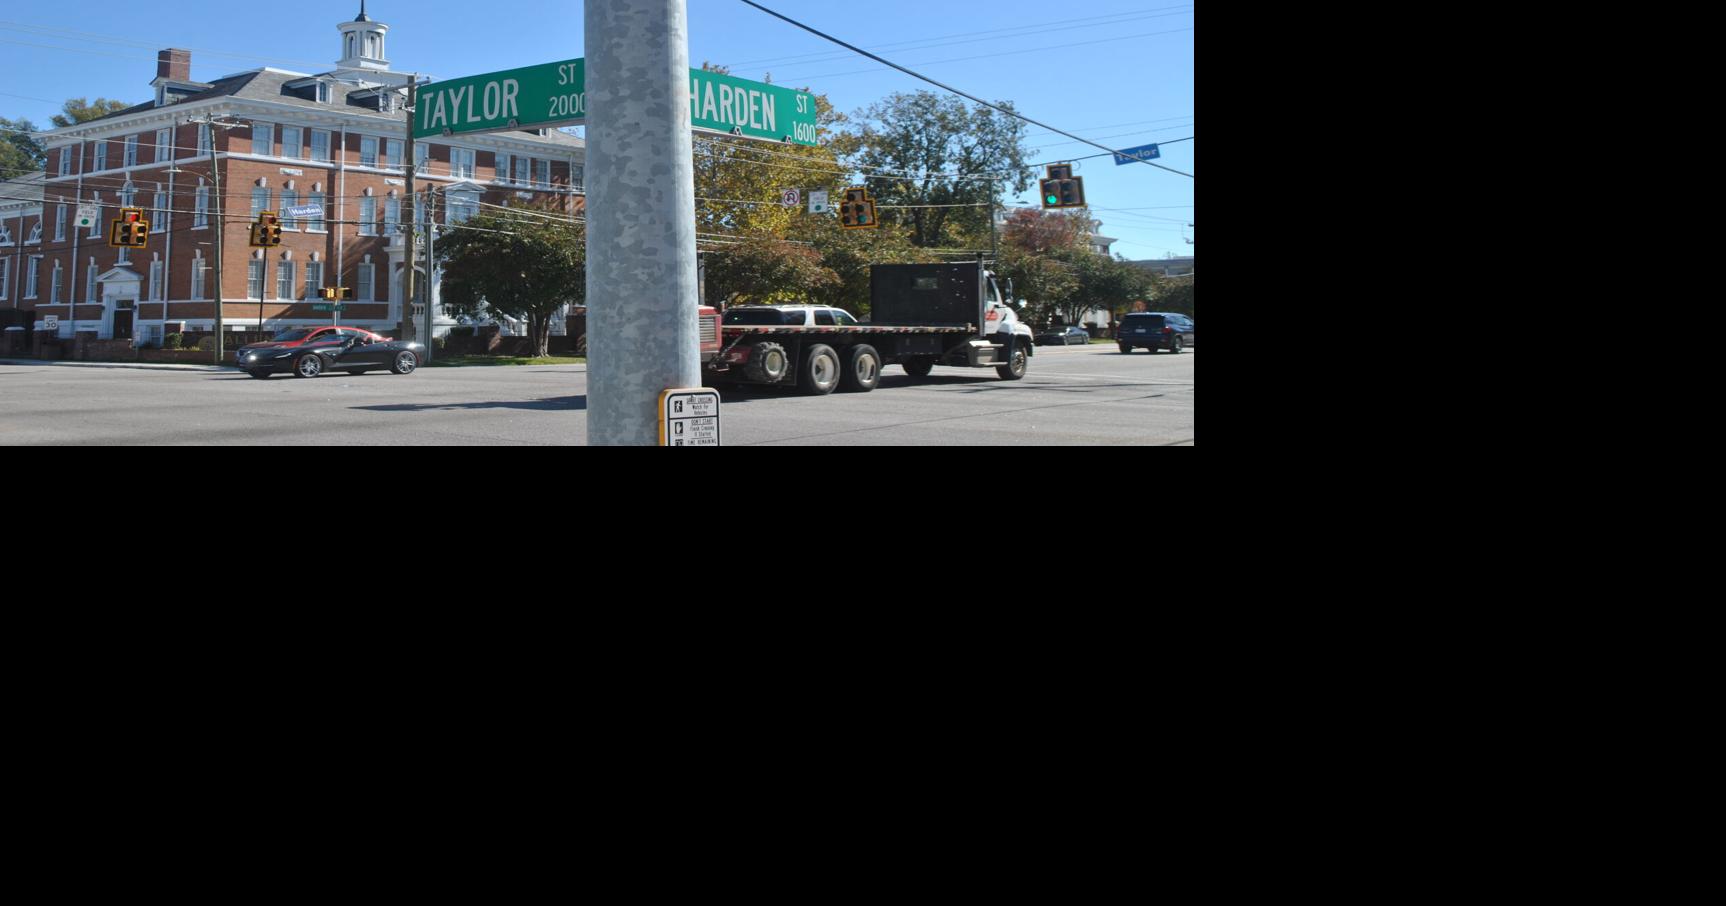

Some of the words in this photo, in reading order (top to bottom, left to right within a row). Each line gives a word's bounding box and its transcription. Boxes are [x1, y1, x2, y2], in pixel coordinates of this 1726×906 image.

[558, 63, 576, 86] ST
[422, 78, 519, 130] TAYLOR
[796, 93, 808, 114] ST
[793, 120, 816, 143] 1600
